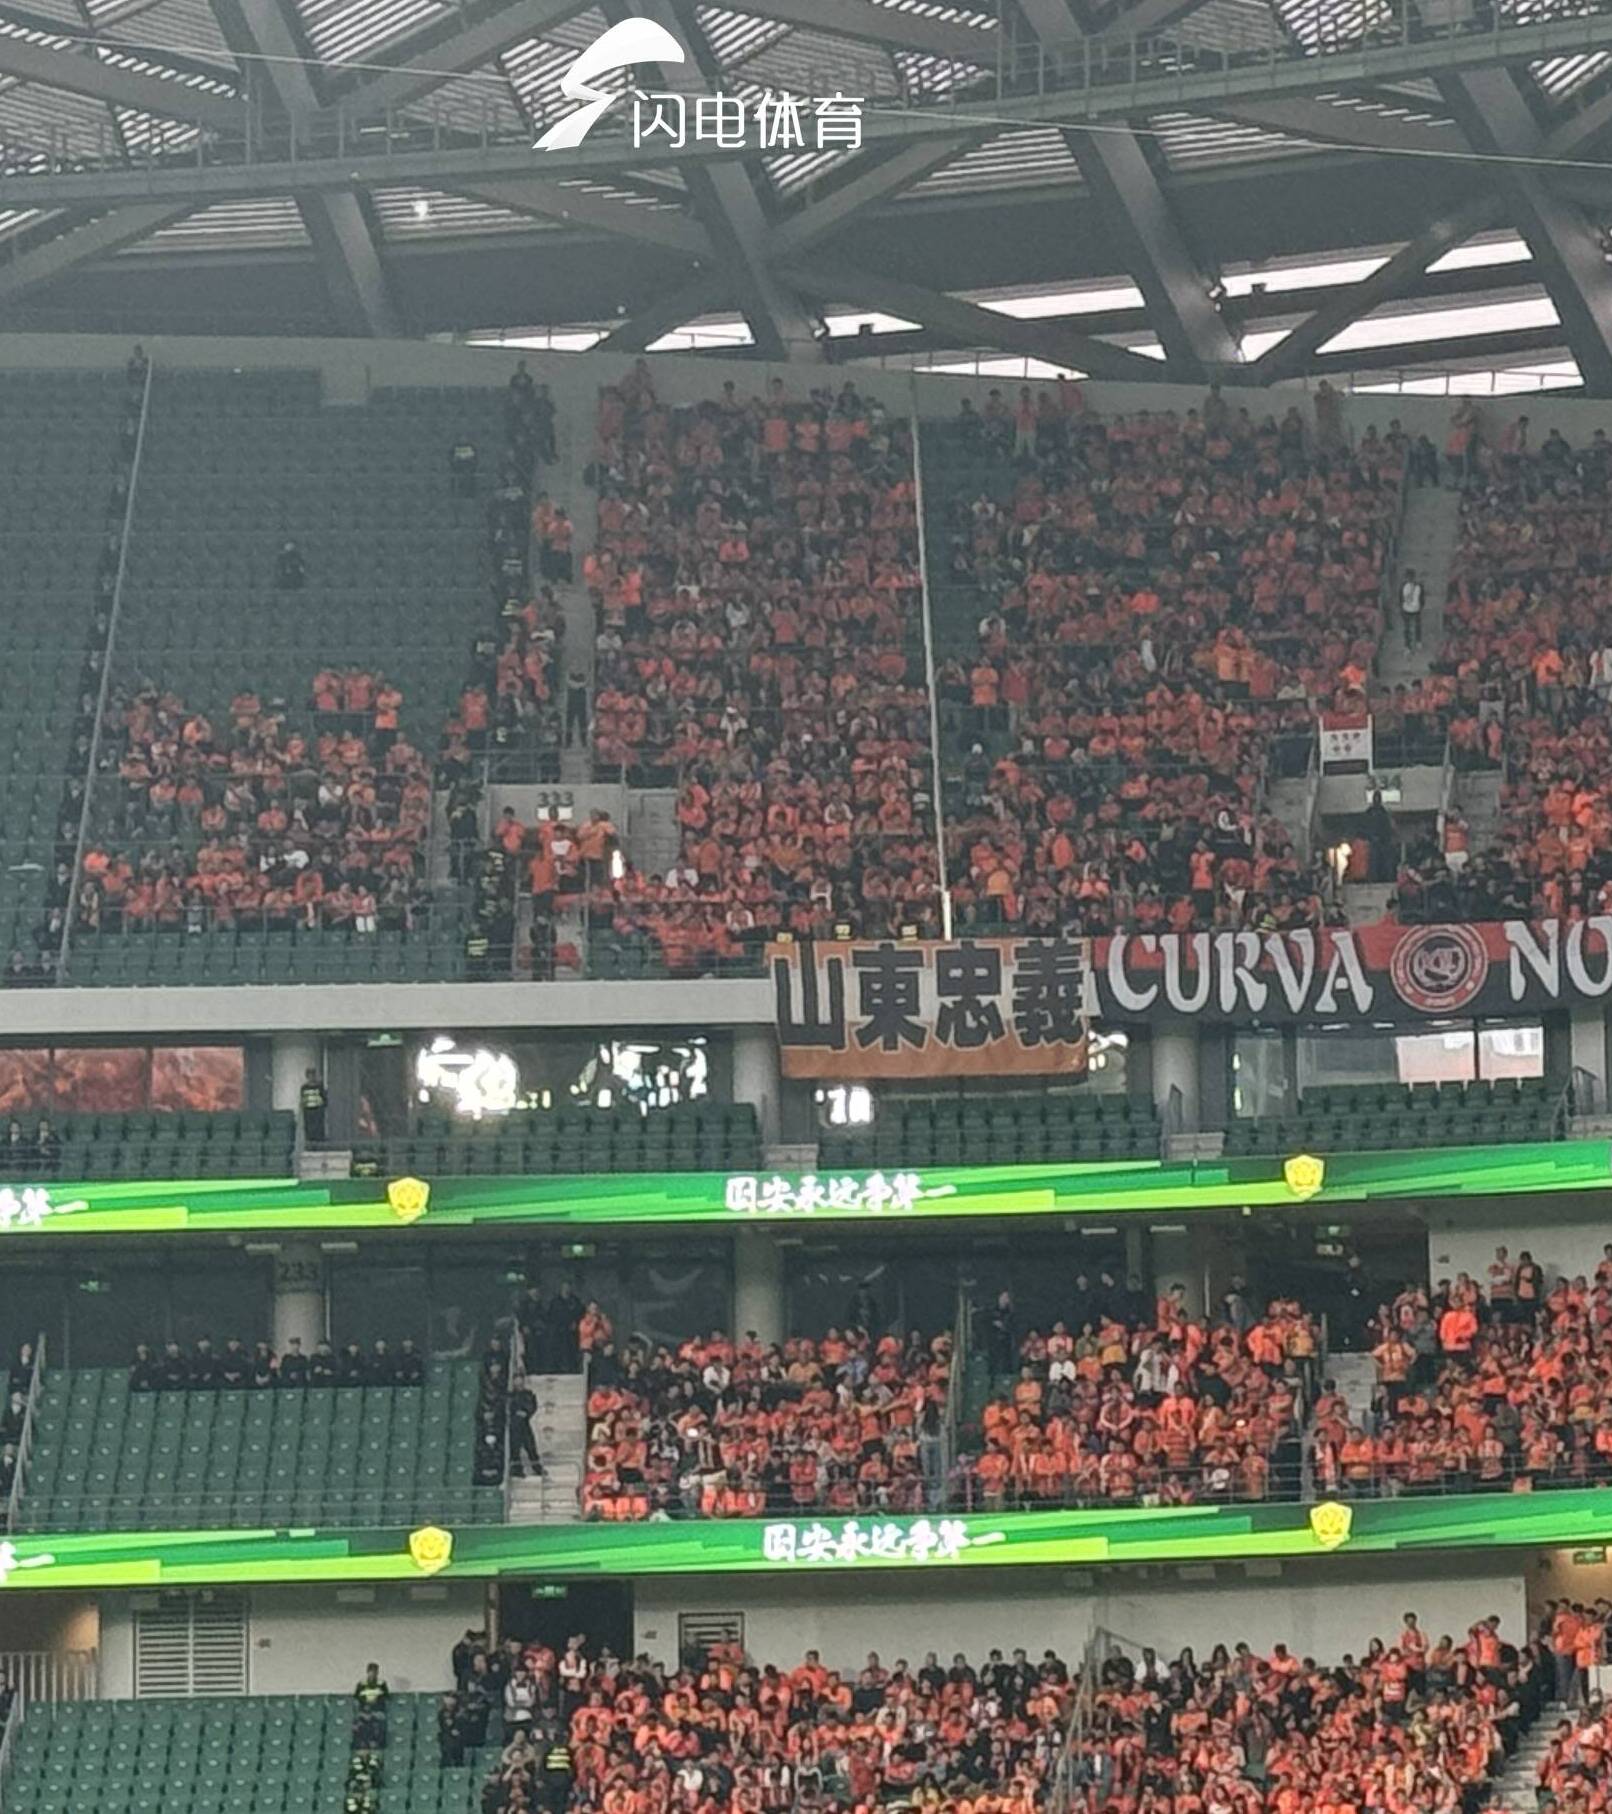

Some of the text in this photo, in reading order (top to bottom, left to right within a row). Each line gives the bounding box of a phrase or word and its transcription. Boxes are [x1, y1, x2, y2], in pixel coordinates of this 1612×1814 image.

[537, 791, 575, 808] 333
[773, 939, 1084, 1051] 山東忠義
[1108, 926, 1375, 1014] CURVA
